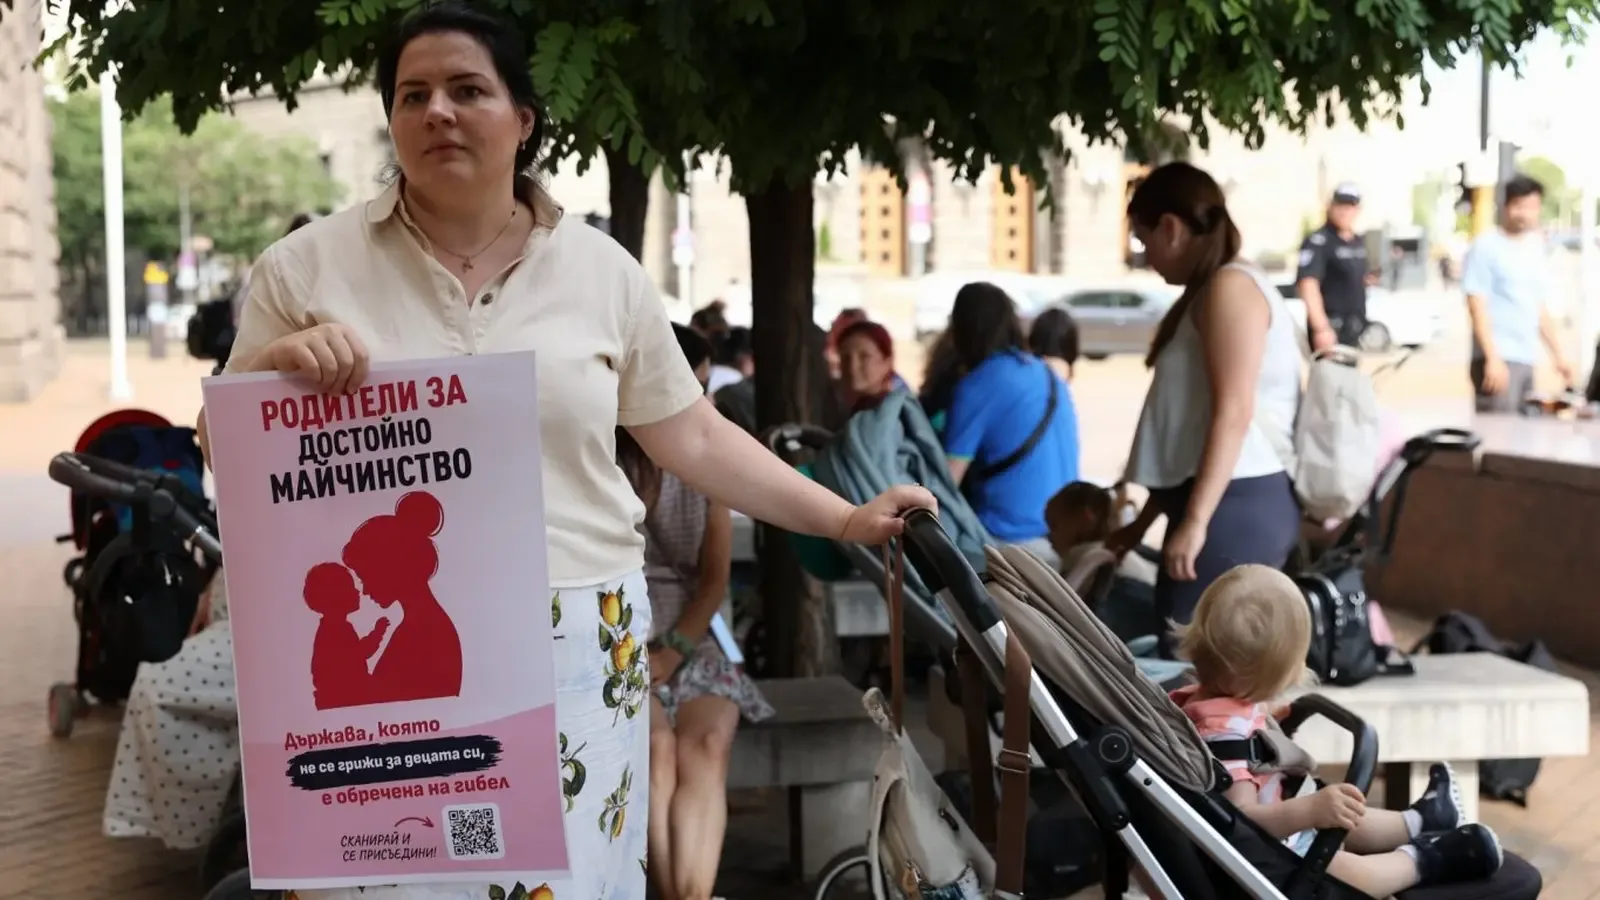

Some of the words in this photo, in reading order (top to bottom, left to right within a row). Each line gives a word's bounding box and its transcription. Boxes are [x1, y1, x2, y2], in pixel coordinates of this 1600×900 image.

[426, 374, 467, 407] ЗА
[298, 416, 432, 465] ДОСТОЙНО
[270, 448, 472, 504] МАЙЧИНСТВО
[284, 726, 374, 750] Държава,
[378, 719, 440, 737] която
[300, 764, 316, 775] не
[319, 762, 334, 773] се
[338, 756, 383, 774] грижи
[386, 754, 401, 770] за
[405, 748, 460, 769] децата
[462, 747, 485, 760] си,
[321, 793, 332, 805] е
[336, 783, 424, 806] обречена
[428, 782, 450, 796] на
[454, 774, 510, 794] гибел
[340, 831, 399, 847] СКАНИРАЙ
[402, 833, 411, 845] И
[343, 850, 356, 862] СЕ
[359, 846, 437, 861] ПРИСЪЕДИНИ!
